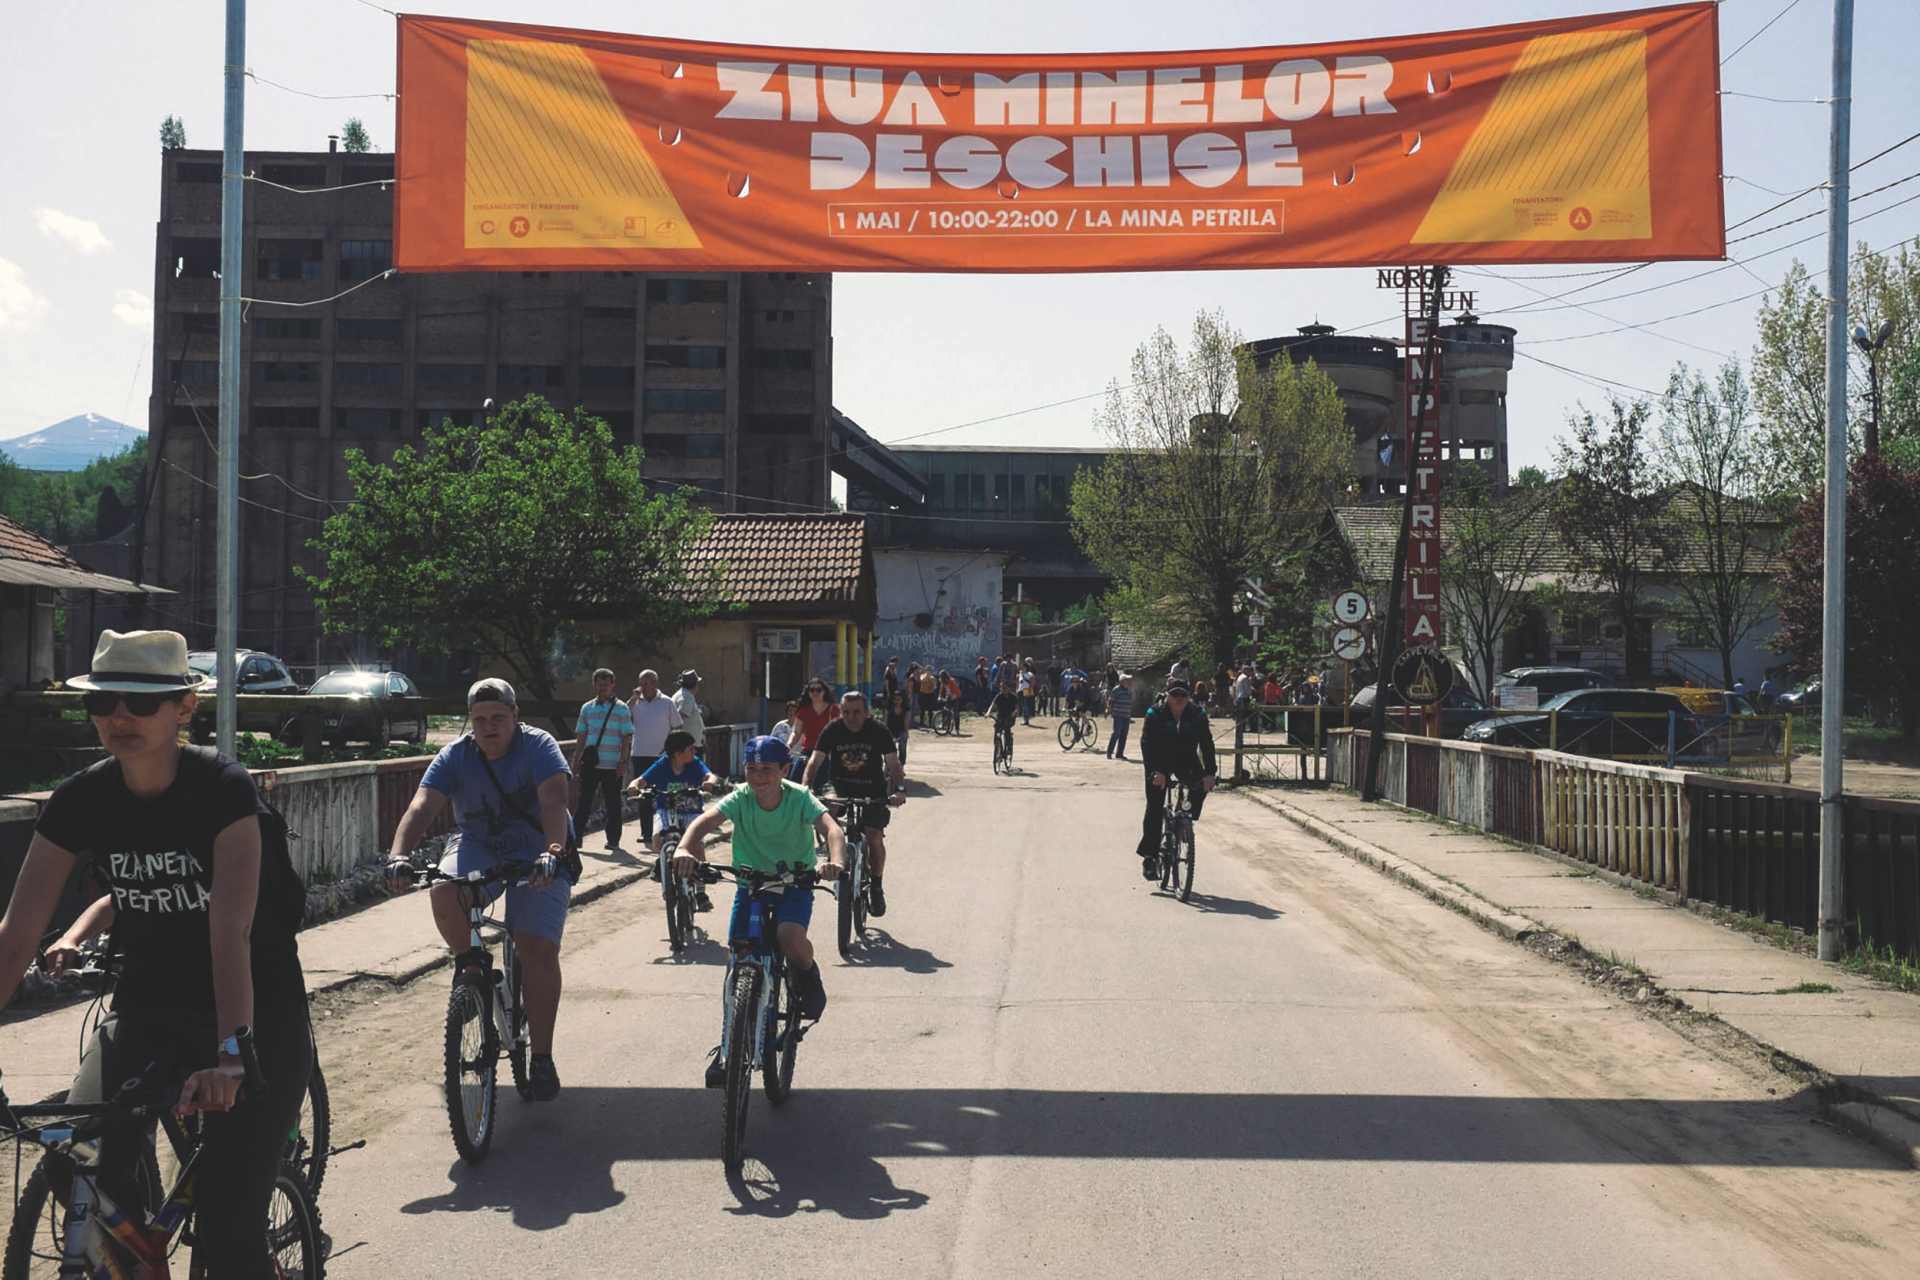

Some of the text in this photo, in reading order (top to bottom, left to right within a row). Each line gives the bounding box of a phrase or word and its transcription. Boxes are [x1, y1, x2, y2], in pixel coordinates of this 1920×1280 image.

[714, 56, 1398, 125] ZIUA MINELOR
[810, 129, 1304, 189] DESCHISE
[837, 212, 846, 229] 1
[856, 211, 900, 229] MAI
[929, 210, 1059, 229] 10:00-22:00
[1085, 209, 1113, 227] LA
[1120, 208, 1184, 227] MINA
[1191, 208, 1277, 227] PETRILA
[1347, 598, 1358, 615] 5
[109, 850, 204, 881] PLANETA
[111, 880, 212, 913] PETRILA
